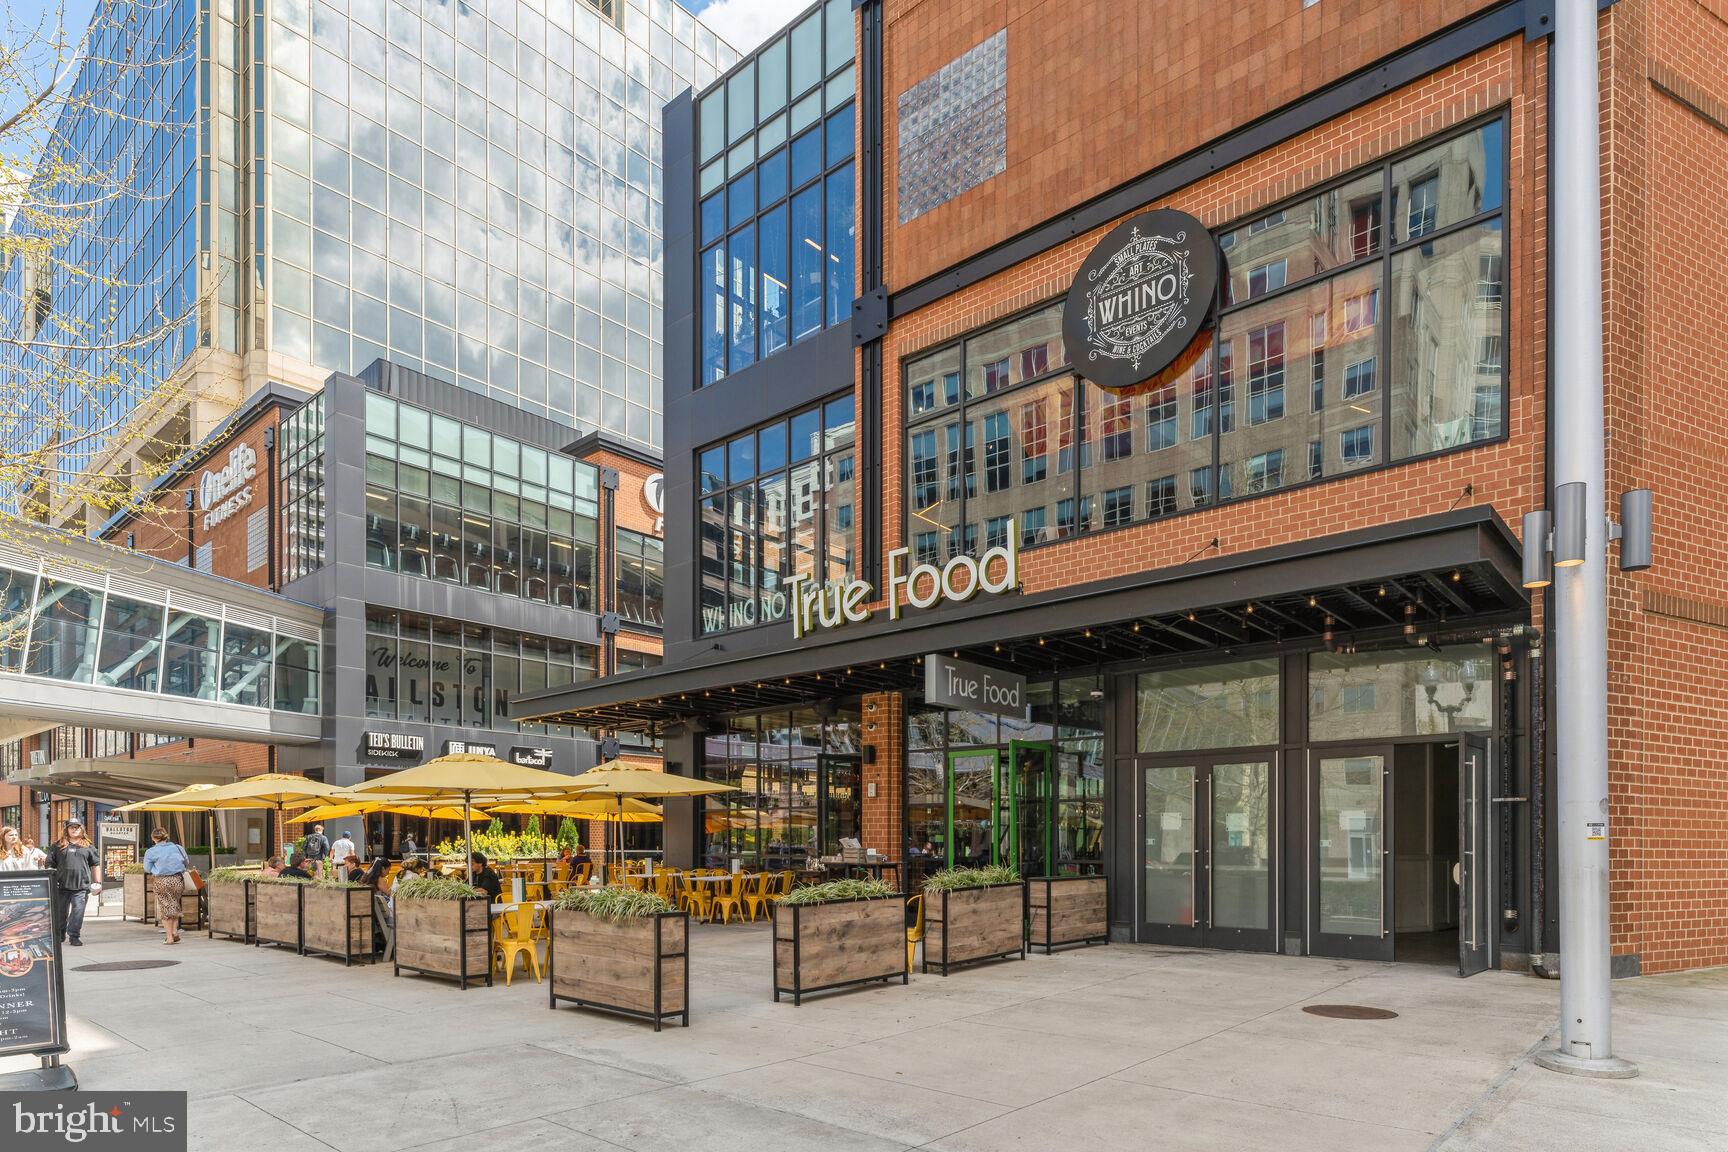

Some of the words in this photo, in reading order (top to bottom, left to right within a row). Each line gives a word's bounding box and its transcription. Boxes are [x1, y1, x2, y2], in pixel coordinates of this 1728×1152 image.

[1114, 247, 1134, 266] SMALL
[1135, 240, 1158, 254] PLATES
[1129, 262, 1144, 276] ART
[1099, 274, 1177, 325] WHINO
[1125, 321, 1148, 336] EVENTS
[1112, 345, 1126, 355] WINE
[1132, 329, 1162, 353] COCKTAILS
[783, 572, 873, 640] True
[888, 518, 1018, 620] Food
[372, 647, 450, 672] Welcome
[456, 655, 482, 675] To
[945, 665, 978, 699] True
[984, 674, 1020, 707] Food
[367, 749, 399, 757] SIDEKICK
[368, 732, 390, 748] TED'S
[391, 734, 424, 751] BULLETIN
[515, 752, 543, 766] bartaco
